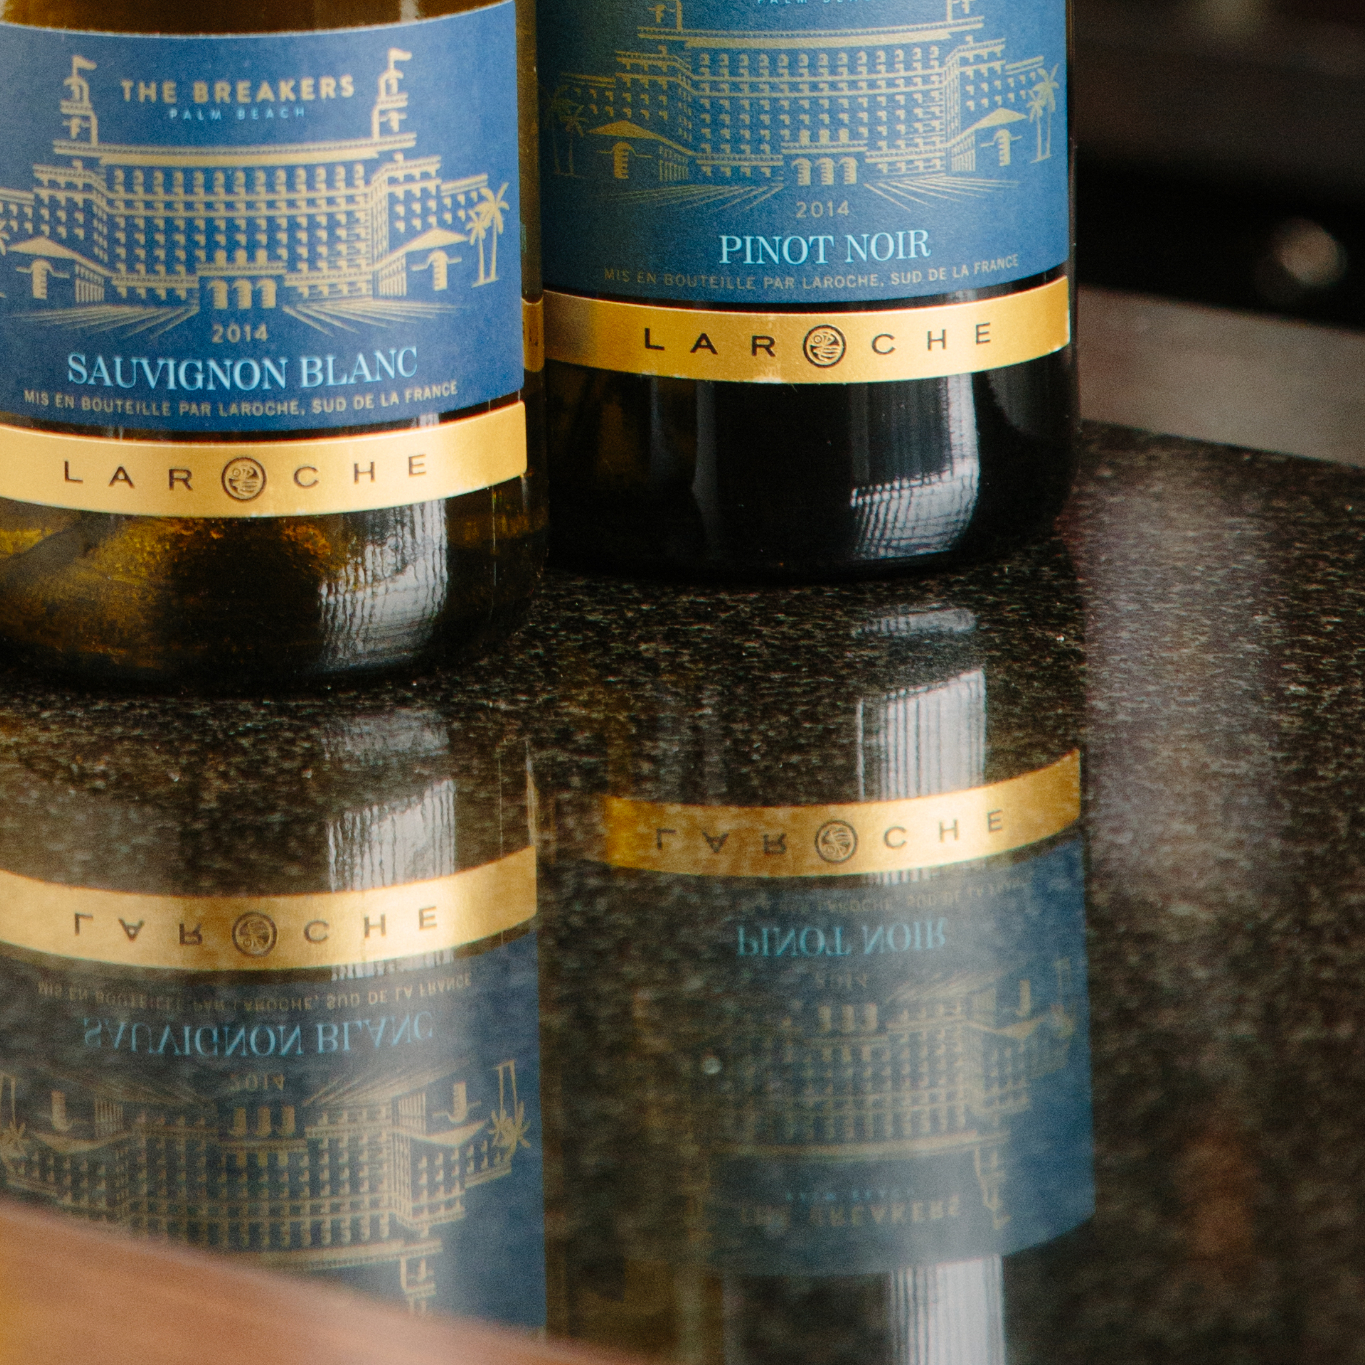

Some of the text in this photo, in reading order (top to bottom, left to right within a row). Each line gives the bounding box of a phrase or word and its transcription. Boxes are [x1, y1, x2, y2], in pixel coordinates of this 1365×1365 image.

[121, 75, 355, 105] THE BREAKERS
[169, 106, 307, 122] PALM BEACH
[794, 200, 851, 220] 2014
[718, 228, 932, 266] PINOT NOIR
[603, 269, 631, 284] MIS
[636, 272, 658, 286] EN
[663, 273, 756, 291] BOUTEILLE
[763, 276, 795, 290] PAR
[891, 270, 923, 287] SUD
[928, 267, 948, 283] DE
[953, 264, 970, 279] LA
[973, 253, 1020, 276] FRANCE
[211, 322, 269, 344] 2014
[66, 345, 418, 391] SAUVIGNON BLANC
[23, 388, 50, 407] MIS
[55, 392, 75, 409] EN
[80, 396, 170, 417] BOUTEILLE
[178, 401, 212, 417] PAR
[312, 396, 348, 415] SUD
[353, 393, 375, 410] DE
[380, 390, 401, 407] LA
[405, 379, 459, 402] FRANCE
